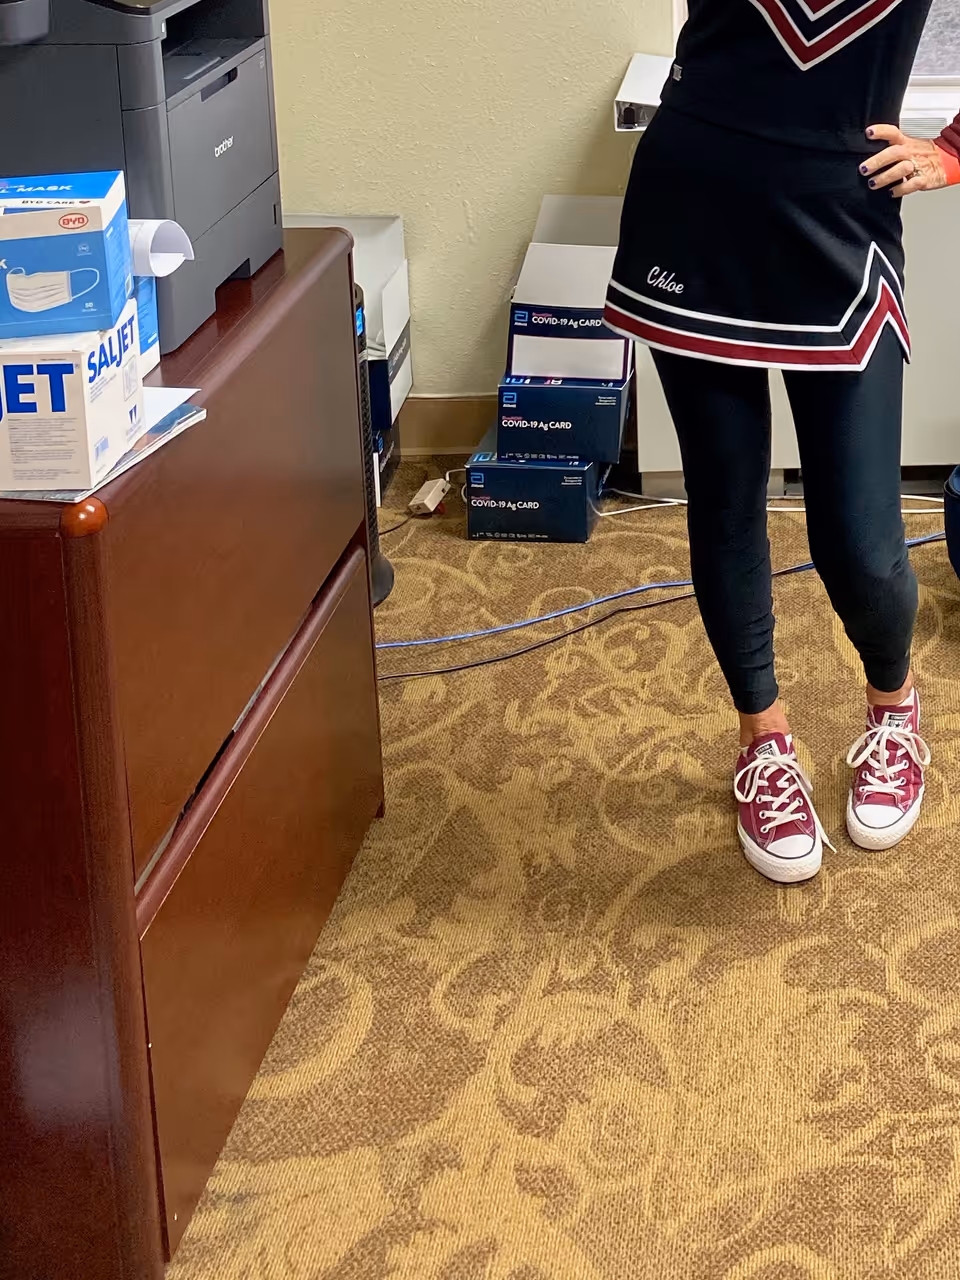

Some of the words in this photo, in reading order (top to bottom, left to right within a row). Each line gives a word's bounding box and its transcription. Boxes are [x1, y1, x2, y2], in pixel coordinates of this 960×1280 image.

[215, 135, 234, 158] brother
[647, 266, 684, 294] Chloe
[532, 316, 567, 325] COVID-19
[568, 319, 578, 328] Ag
[579, 319, 601, 327] CARD
[87, 315, 135, 383] SALJET
[502, 420, 538, 428] COVID-19
[538, 421, 549, 431] Ag
[549, 421, 572, 429] CARD
[471, 500, 506, 508] COVID-19
[507, 501, 516, 510] Ag
[517, 501, 540, 509] CARD
